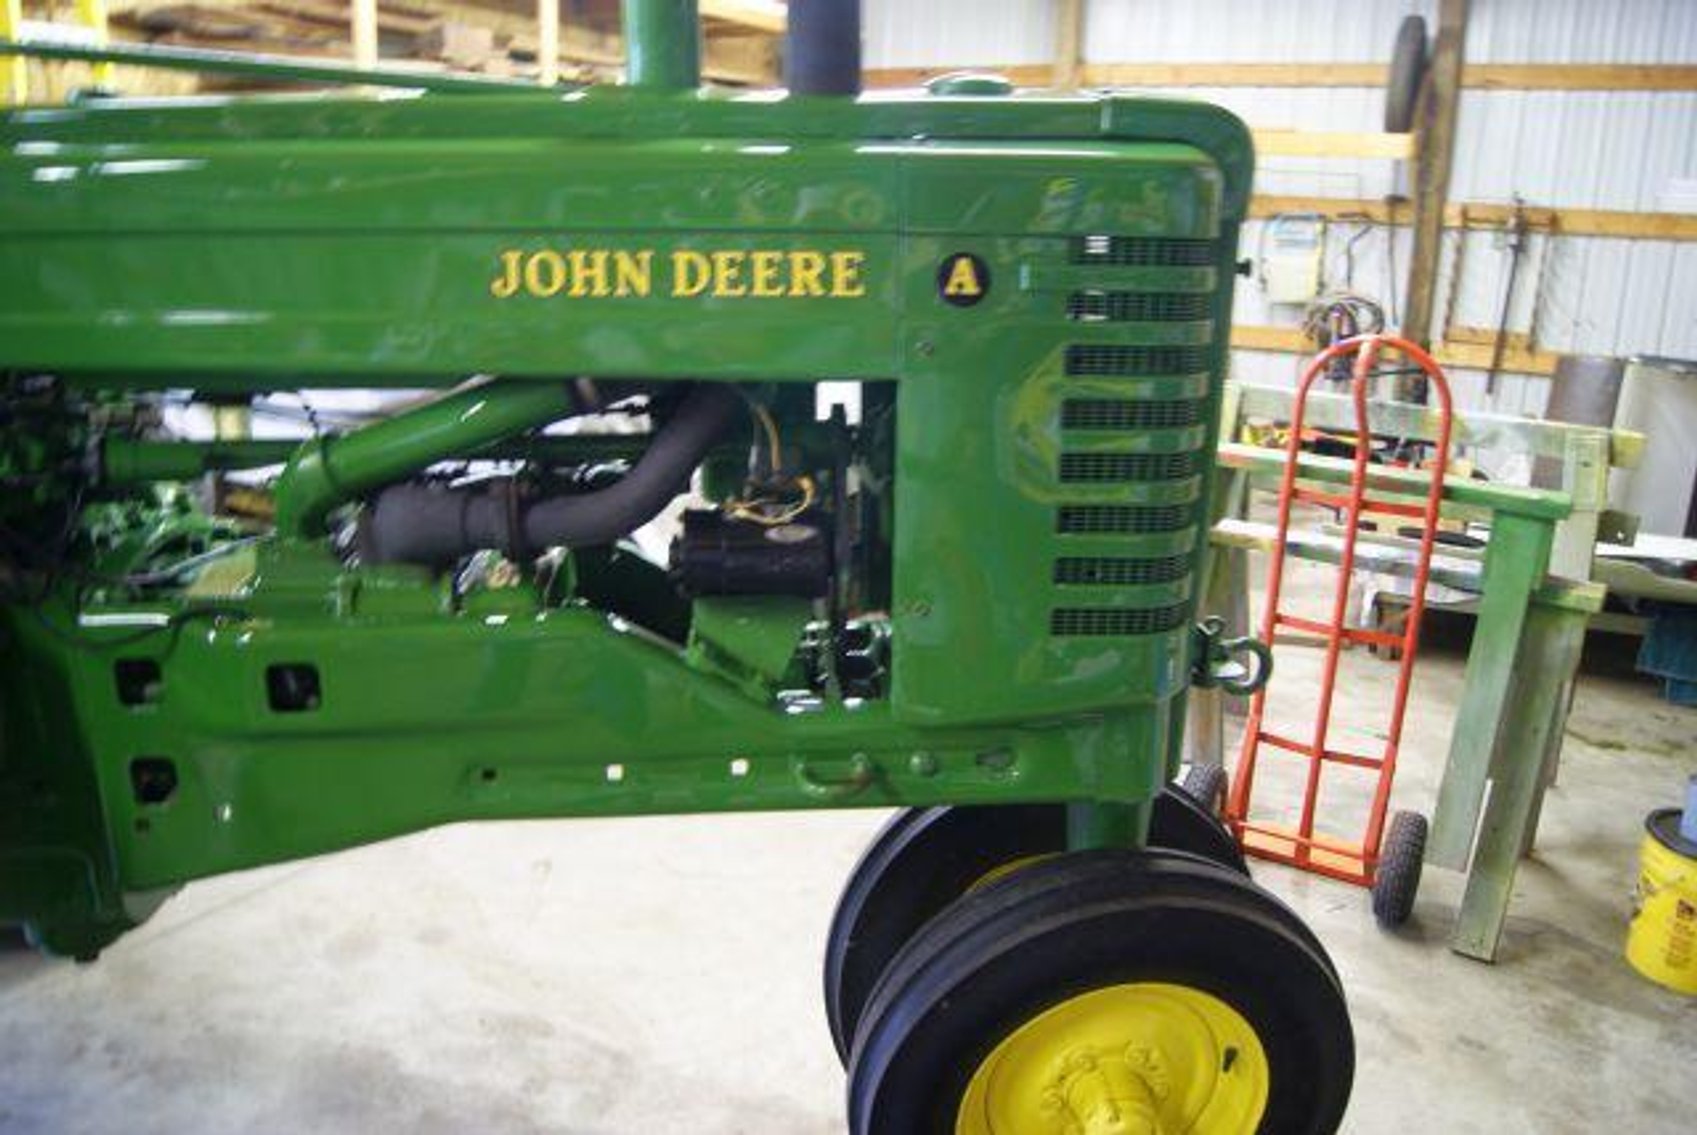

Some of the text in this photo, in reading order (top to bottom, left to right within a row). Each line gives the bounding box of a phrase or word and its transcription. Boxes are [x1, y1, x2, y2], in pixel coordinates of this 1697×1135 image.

[490, 249, 866, 298] JOHN DEERE
[944, 256, 981, 295] A
